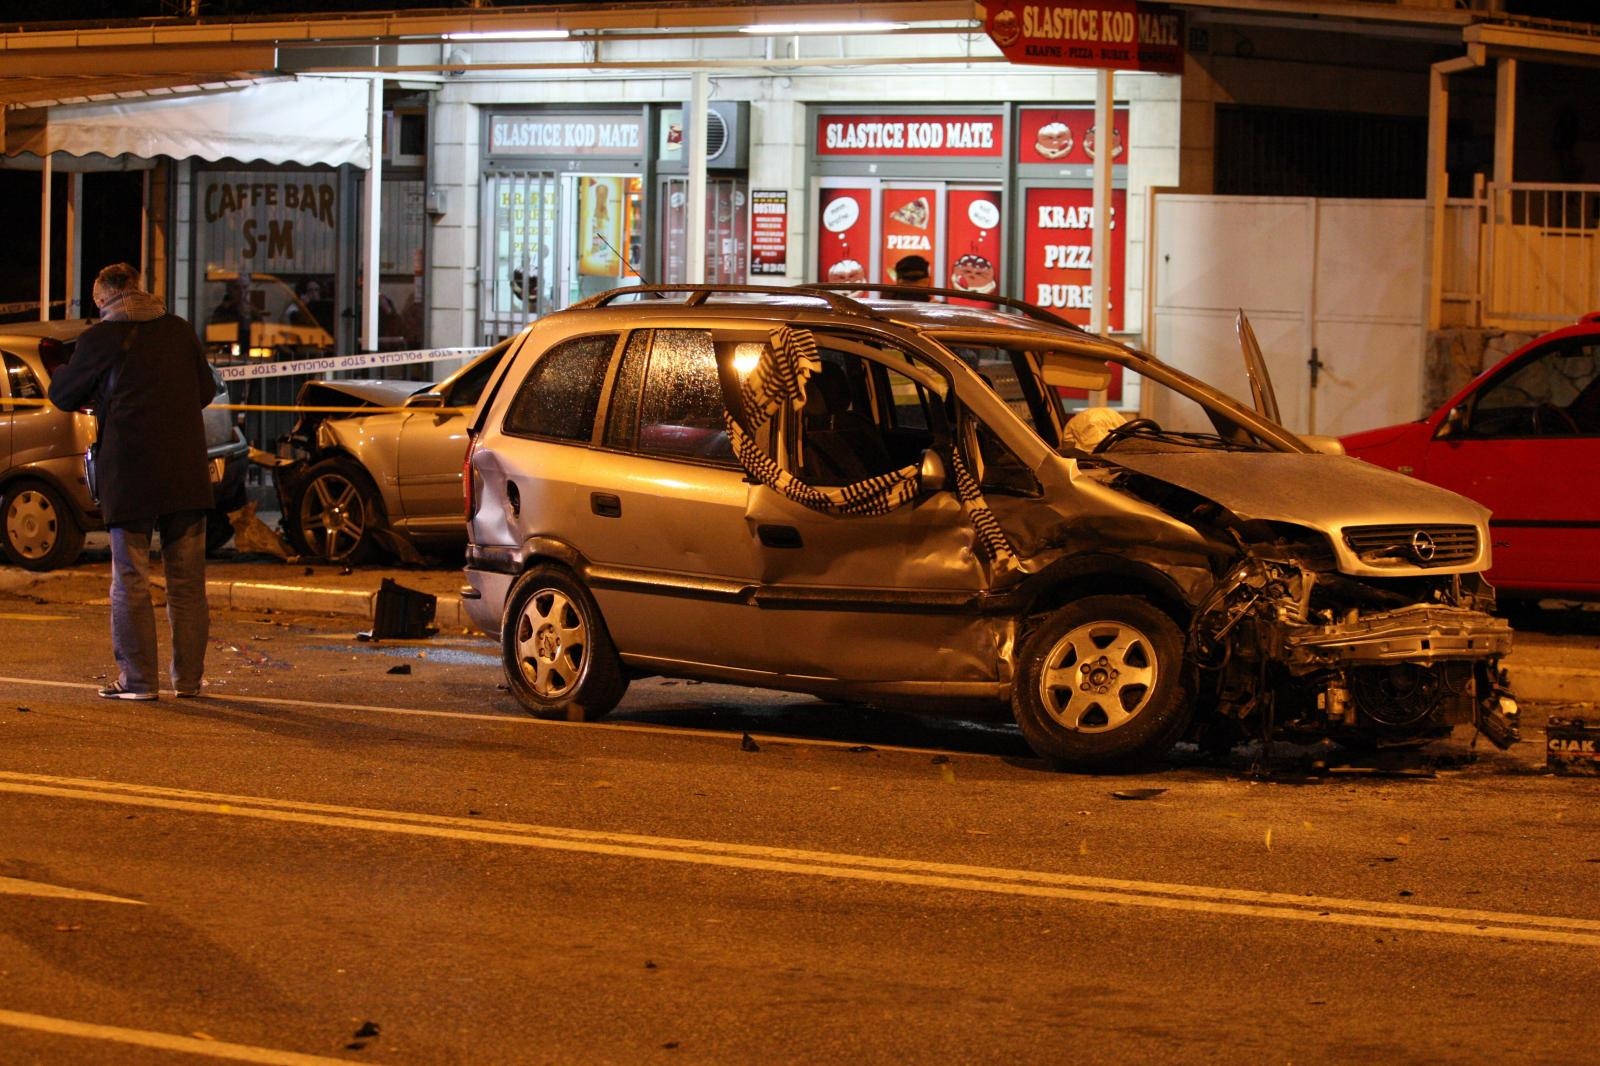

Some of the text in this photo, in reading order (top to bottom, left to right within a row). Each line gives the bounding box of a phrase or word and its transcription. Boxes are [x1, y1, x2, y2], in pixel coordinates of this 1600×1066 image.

[1023, 6, 1178, 46] SLASTICE KOD MATE
[1069, 47, 1094, 60] PIZZA
[493, 123, 640, 147] SLASTICE KOD MATE
[826, 122, 993, 149] SLASTICE KOD MATE
[205, 183, 334, 229] CAFFE BAR
[1038, 206, 1115, 230] KRAF
[242, 219, 294, 259] S-M
[887, 235, 931, 250] PIZZA
[1044, 245, 1093, 269] PIZZ
[1037, 284, 1112, 309] BURE
[291, 360, 335, 371] POLICIJA
[341, 356, 367, 367] STOP
[380, 352, 423, 363] POLICIJA
[251, 364, 277, 376] STOP
[1548, 739, 1595, 752] CIAK
